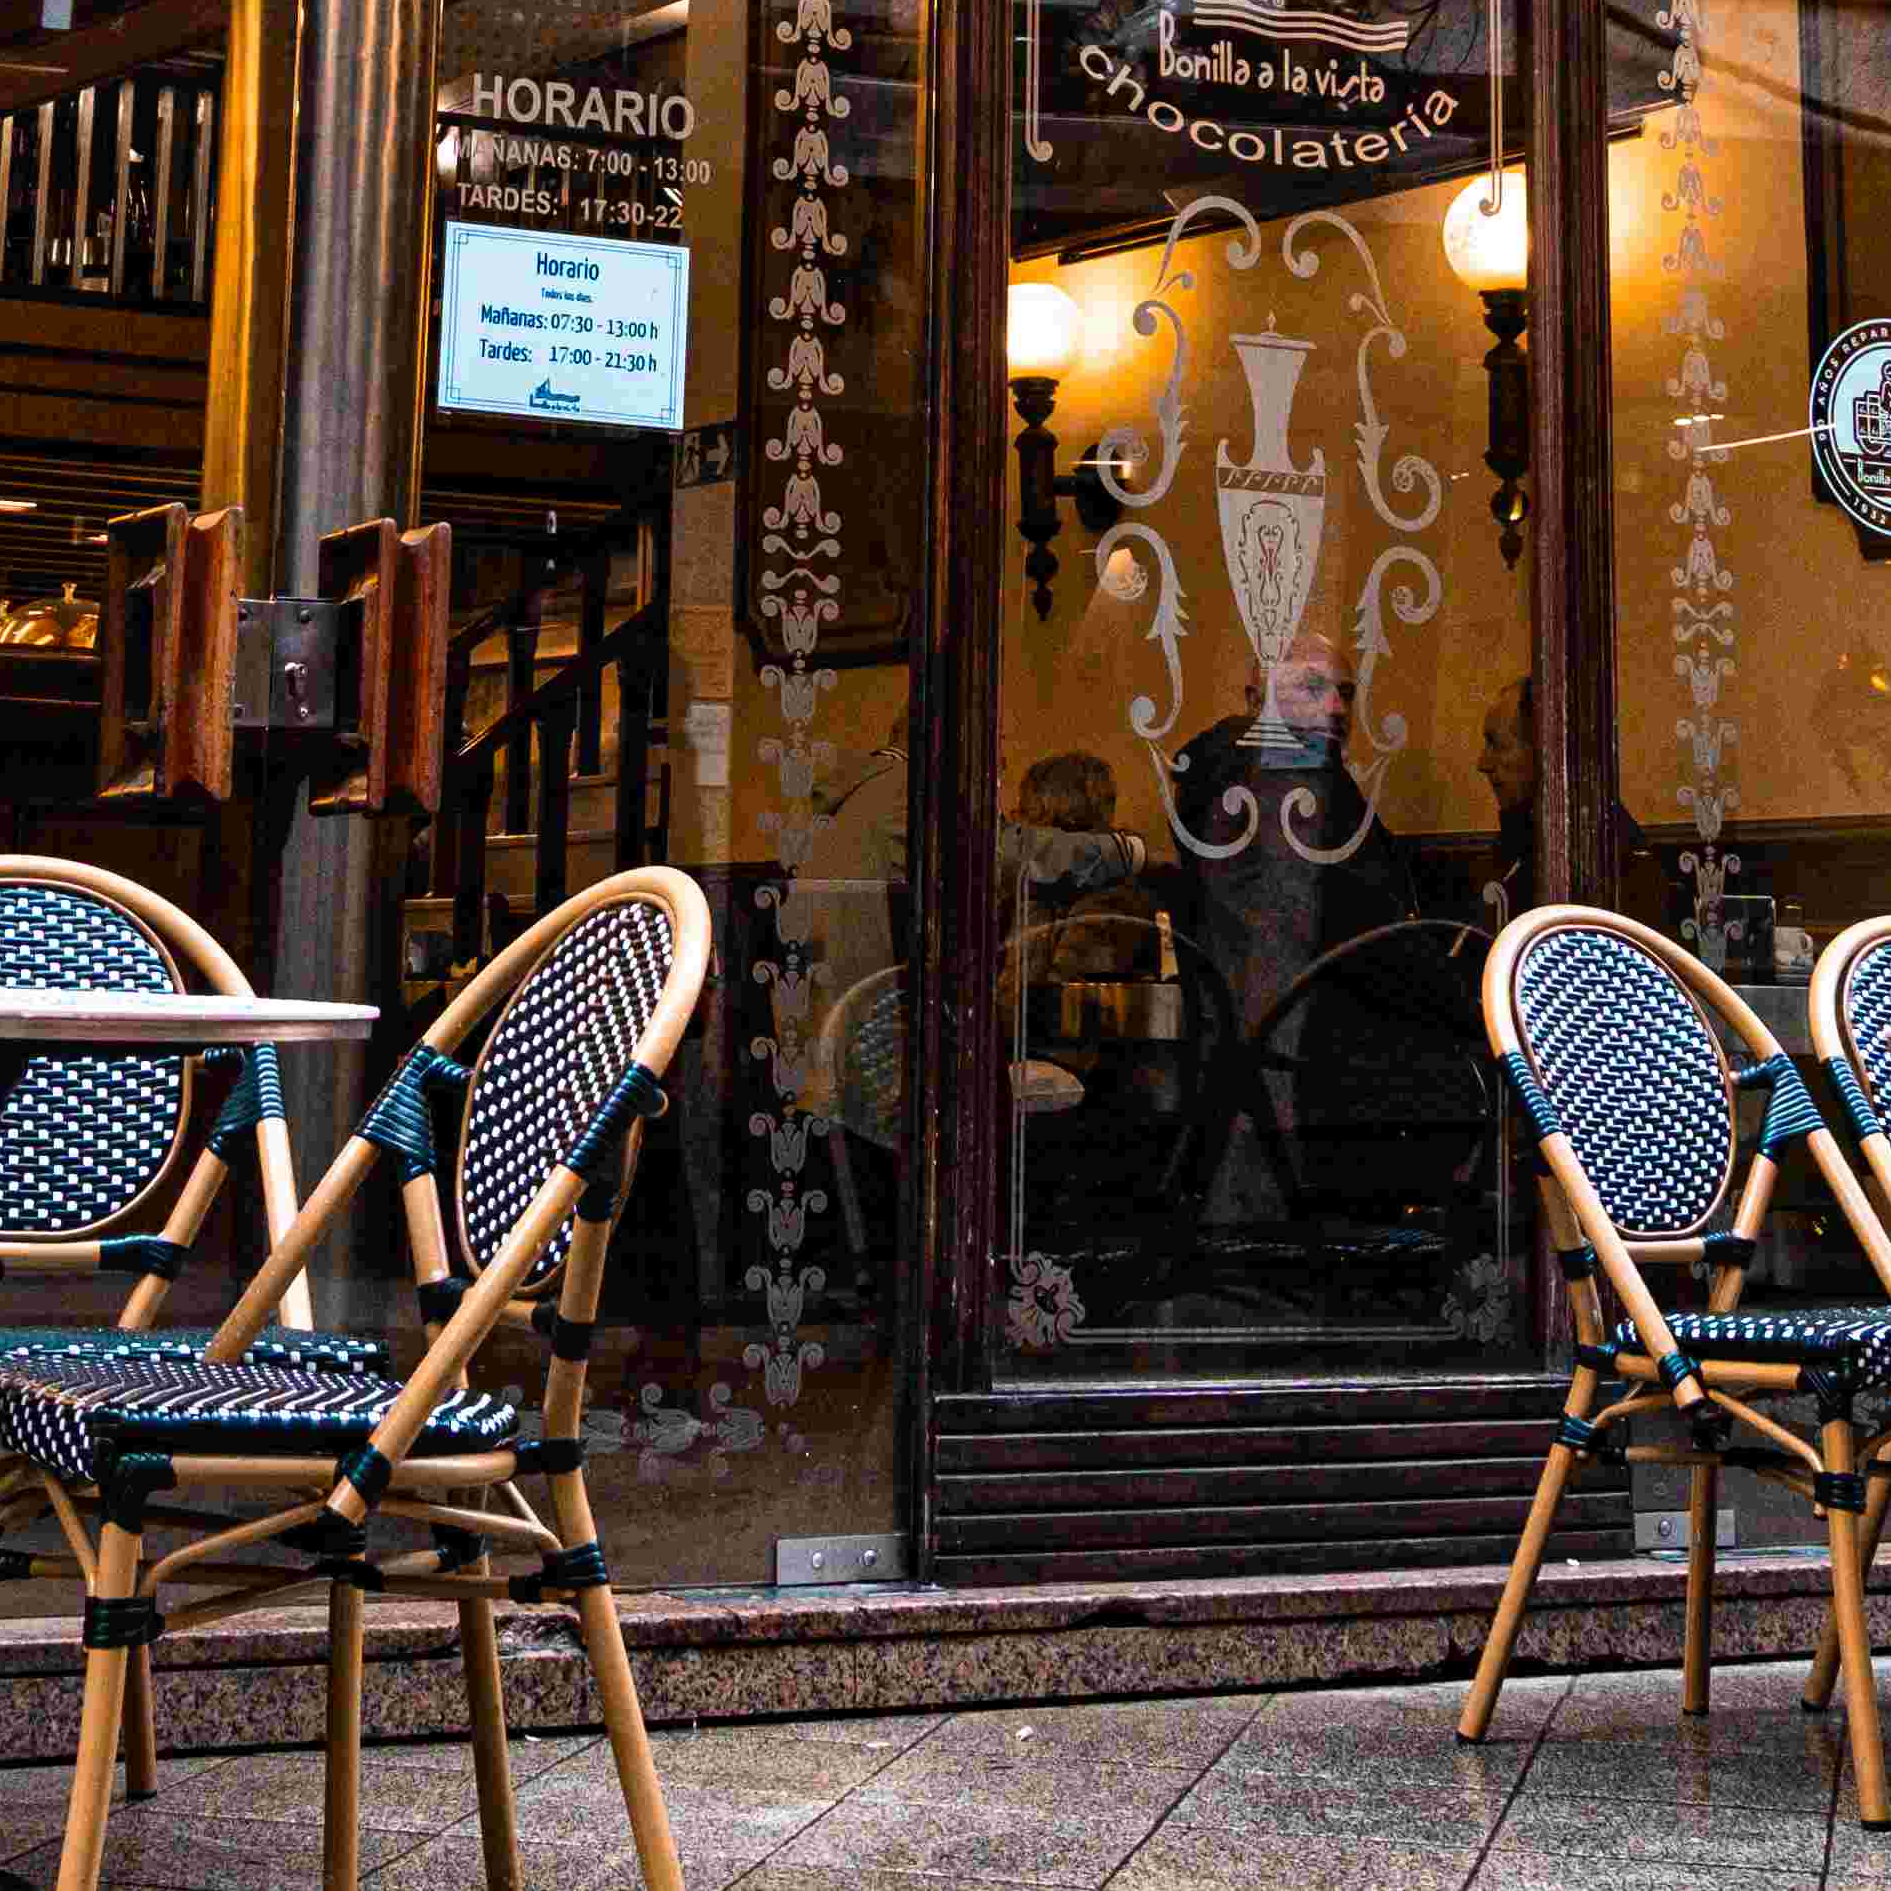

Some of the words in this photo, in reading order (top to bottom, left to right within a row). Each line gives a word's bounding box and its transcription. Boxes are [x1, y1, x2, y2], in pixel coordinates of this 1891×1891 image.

[1159, 9, 1250, 85] Bonilla
[1258, 61, 1274, 89] a
[1284, 48, 1309, 94] la
[1315, 58, 1386, 103] vista
[473, 72, 695, 140] HORARIO
[1078, 44, 1459, 169] chocolatería
[455, 132, 579, 170] MAÑANAS:
[586, 148, 632, 176] 7:00
[654, 156, 711, 185] 13:00
[456, 182, 559, 216] TARDES:
[536, 252, 600, 281] Horario
[480, 303, 548, 330] Mañanas:
[551, 314, 593, 333] 07:30
[607, 319, 647, 339] 13:00
[650, 321, 658, 340] h
[480, 339, 532, 363] Tardes:
[549, 346, 591, 365] 17:00
[605, 352, 645, 372] 21:30
[648, 354, 657, 373] h
